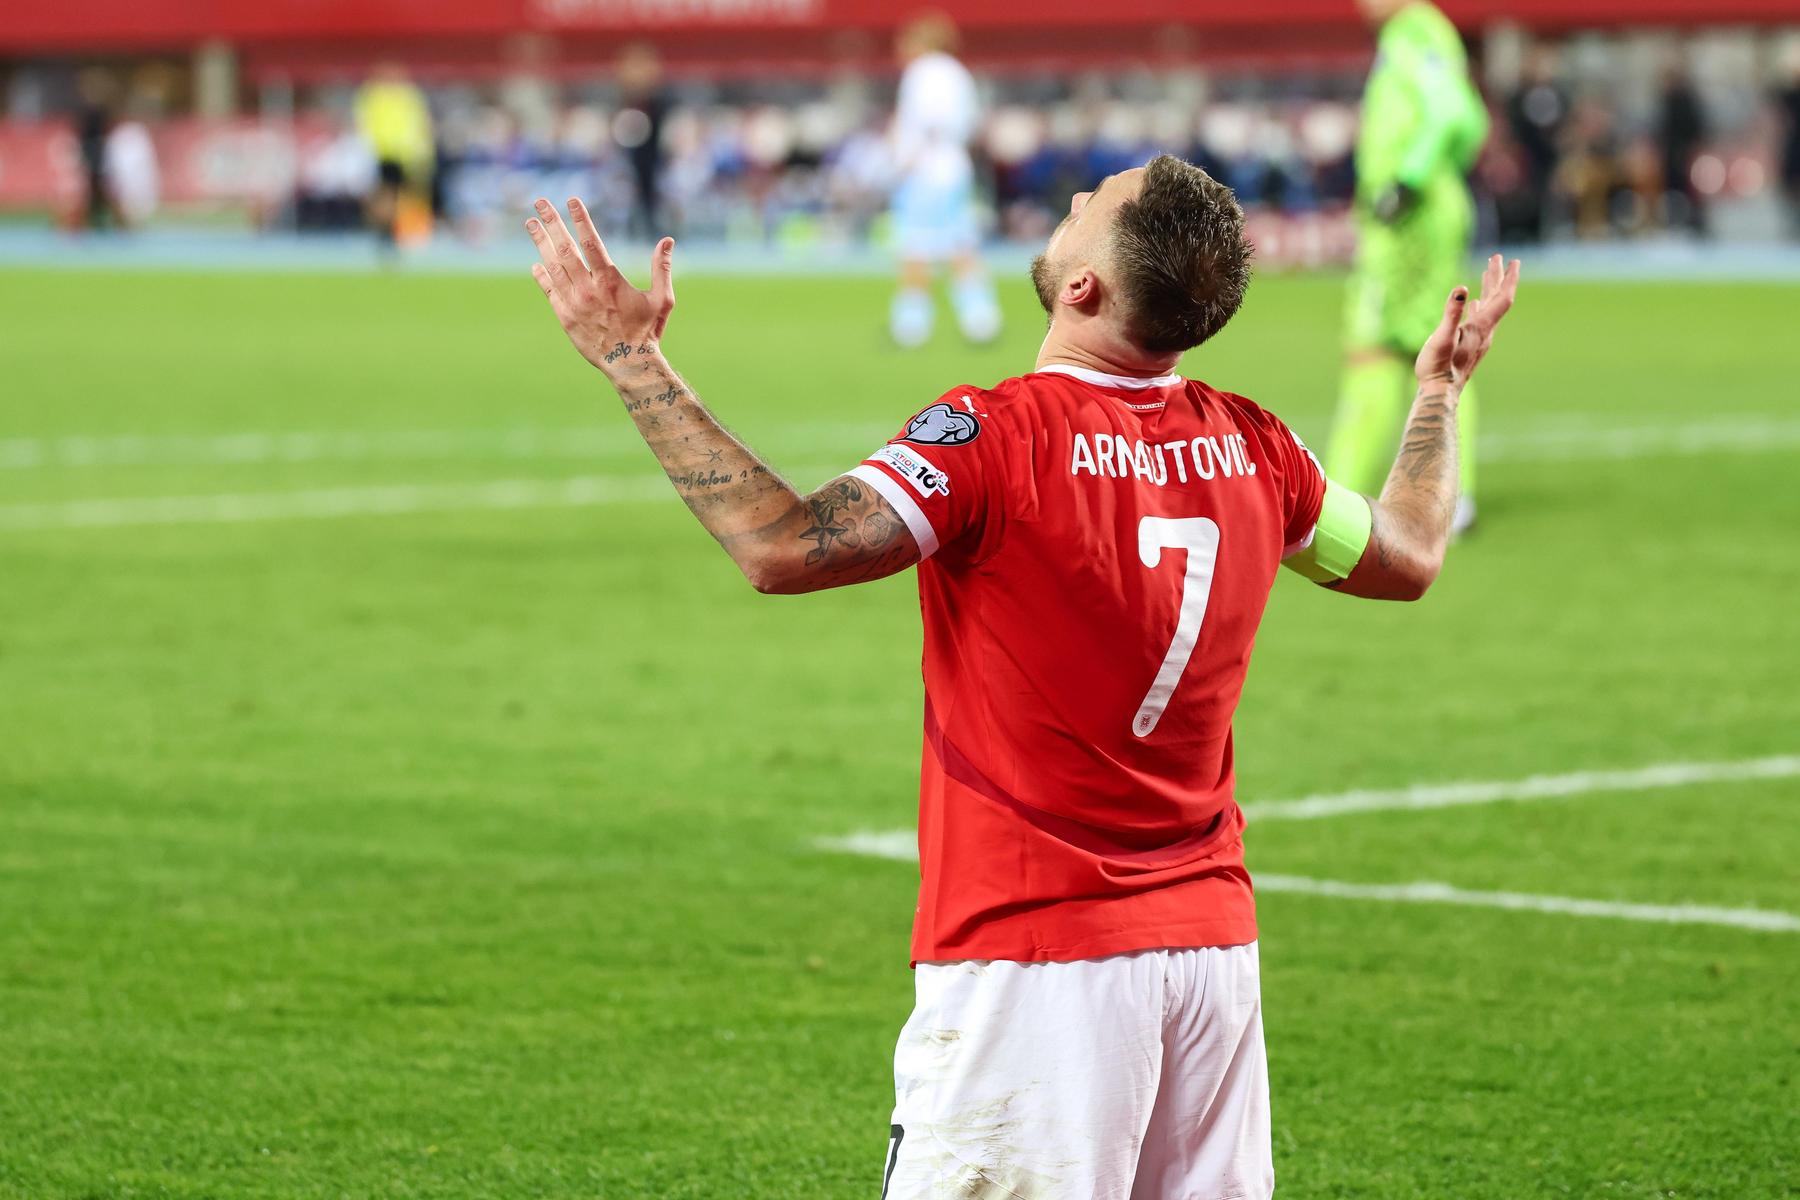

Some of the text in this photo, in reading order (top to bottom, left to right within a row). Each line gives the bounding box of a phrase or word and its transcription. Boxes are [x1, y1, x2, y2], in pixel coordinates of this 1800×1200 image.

[916, 466, 938, 489] 10
[1071, 433, 1256, 486] ARNAUTOVIC
[1132, 516, 1220, 737] 7
[881, 1124, 905, 1200] 7
